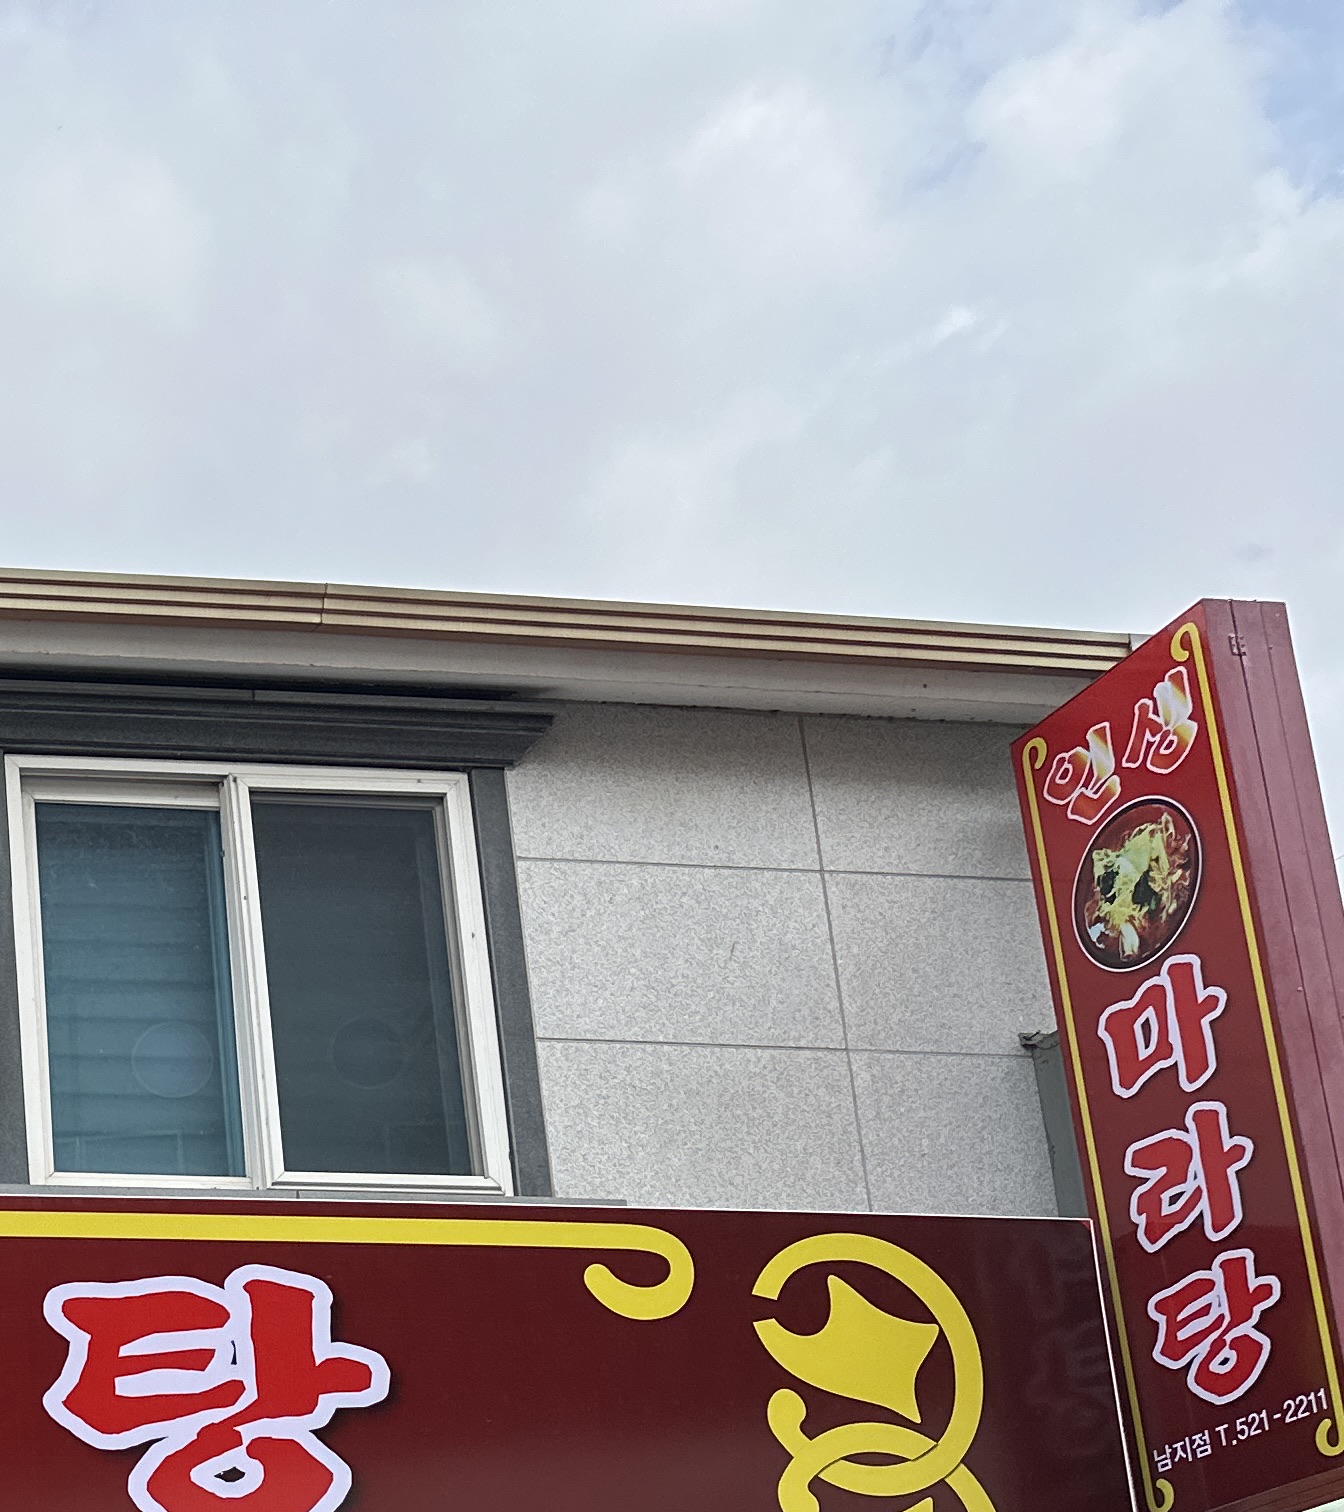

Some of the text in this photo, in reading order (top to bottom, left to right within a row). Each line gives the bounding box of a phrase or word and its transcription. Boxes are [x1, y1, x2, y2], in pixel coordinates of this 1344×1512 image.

[1043, 665, 1198, 825] 인생
[1098, 954, 1280, 1405] 마라탕
[1152, 1432, 1212, 1473] 남지점
